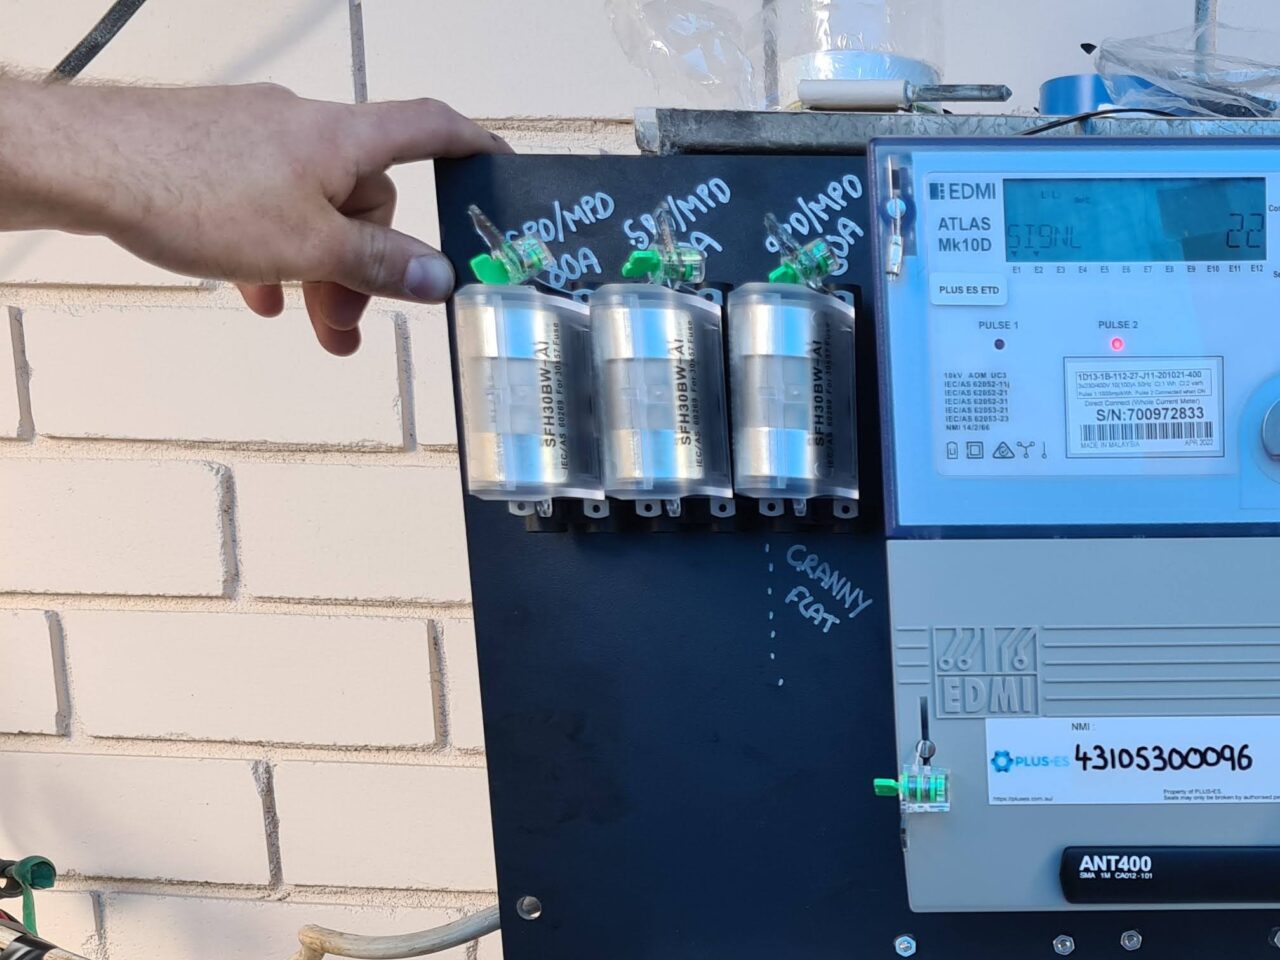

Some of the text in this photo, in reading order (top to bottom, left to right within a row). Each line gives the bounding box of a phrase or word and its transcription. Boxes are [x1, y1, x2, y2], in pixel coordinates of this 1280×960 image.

[949, 182, 996, 200] EDMI
[938, 217, 991, 231] ATLAS
[1226, 212, 1265, 249] 22
[938, 238, 992, 252] Mk10D
[1012, 266, 1021, 274] E1
[1034, 266, 1043, 274] E2
[1056, 266, 1065, 274] E3
[1187, 265, 1196, 273] E9
[1207, 264, 1220, 272] E10
[1229, 264, 1241, 272] E11
[1251, 264, 1264, 272] E12
[939, 286, 1000, 295] PLUS ES ETD
[979, 321, 1019, 329] PULSE 1
[1098, 320, 1138, 329] PULSE 2
[1096, 407, 1204, 421] S/N:700972833
[943, 677, 1032, 714] EDMI
[1071, 722, 1090, 731] NMI
[1075, 744, 1253, 771] 43105300096
[1079, 855, 1152, 872] ANT400
